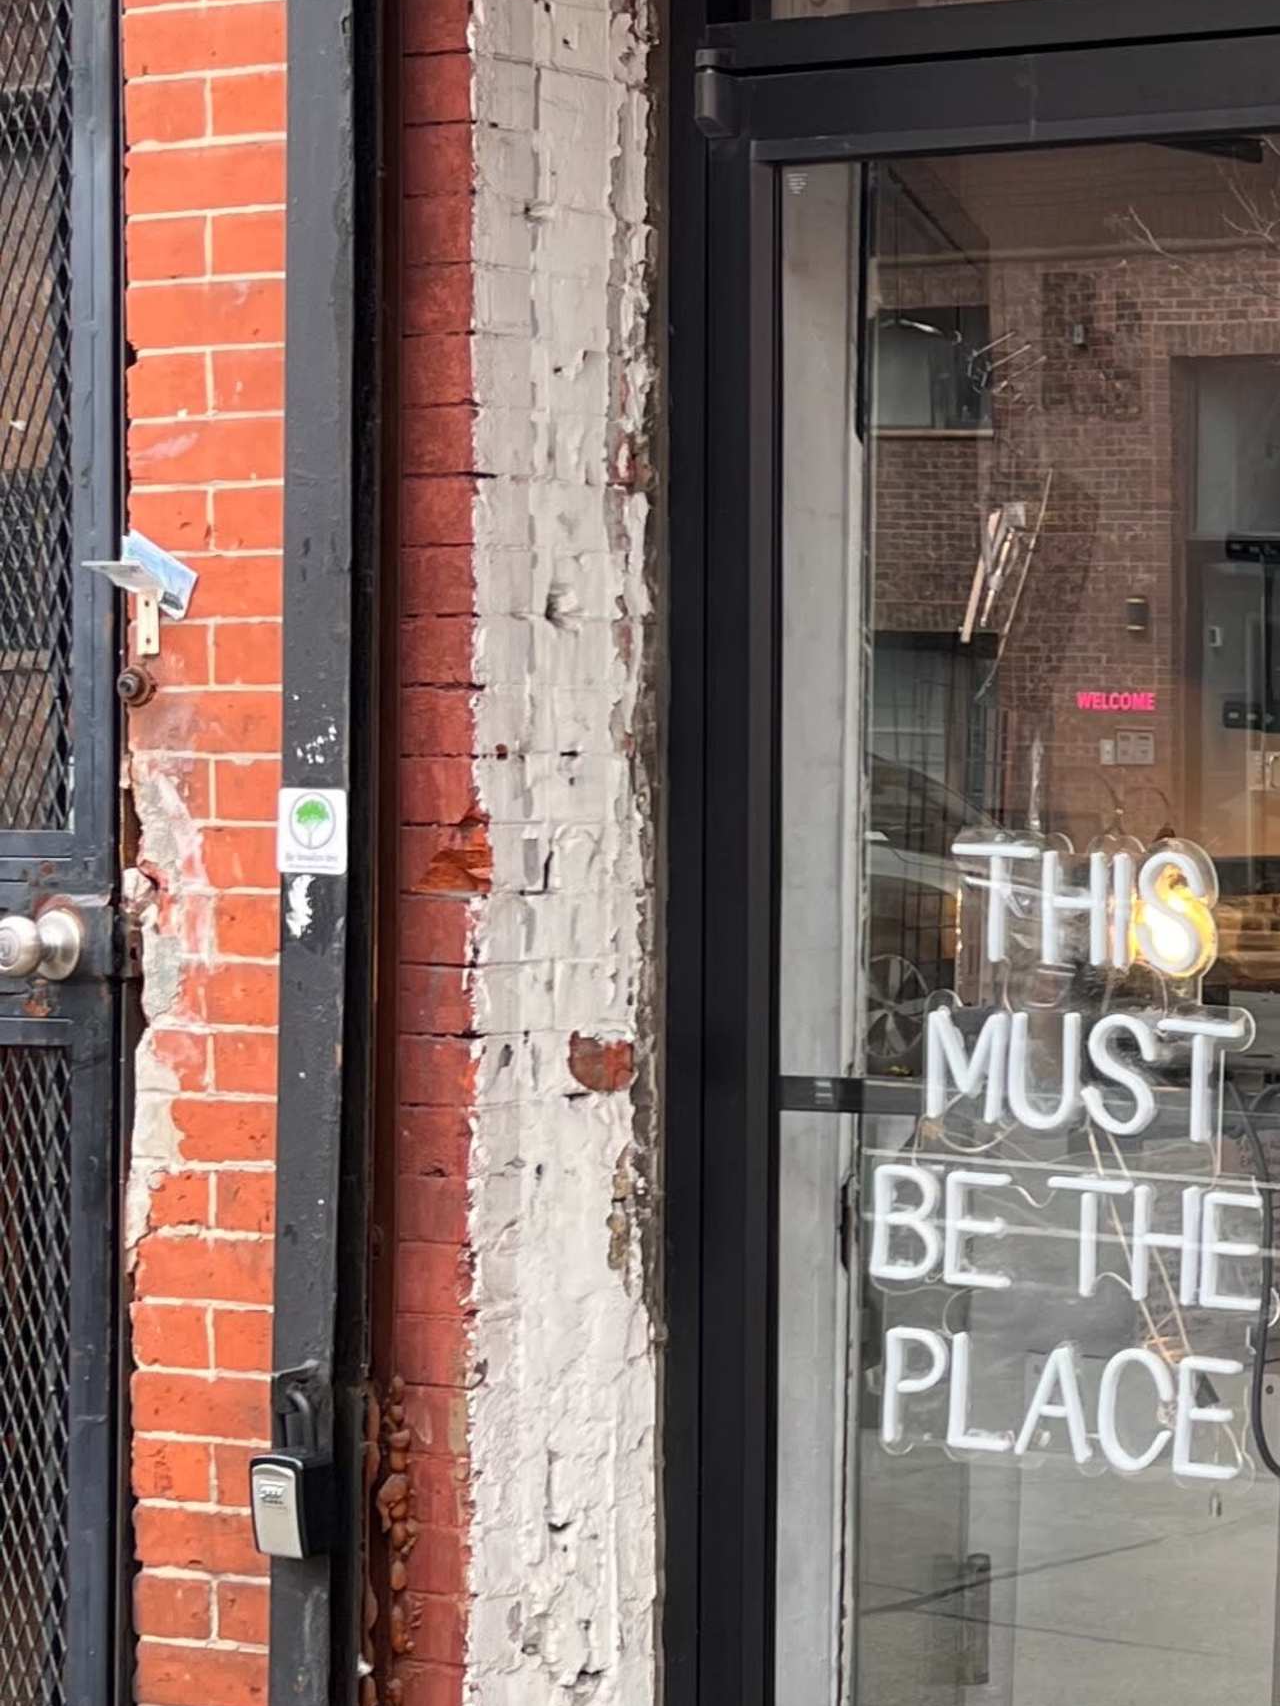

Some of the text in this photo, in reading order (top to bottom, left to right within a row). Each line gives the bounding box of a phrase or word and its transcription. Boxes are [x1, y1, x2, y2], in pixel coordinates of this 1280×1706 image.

[1076, 691, 1156, 711] WELCOME
[951, 842, 1201, 977] THIS
[927, 1005, 1247, 1141] MUST
[869, 1163, 1013, 1287] BE
[1048, 1175, 1264, 1312] THE
[883, 1326, 1244, 1479] PLACE
